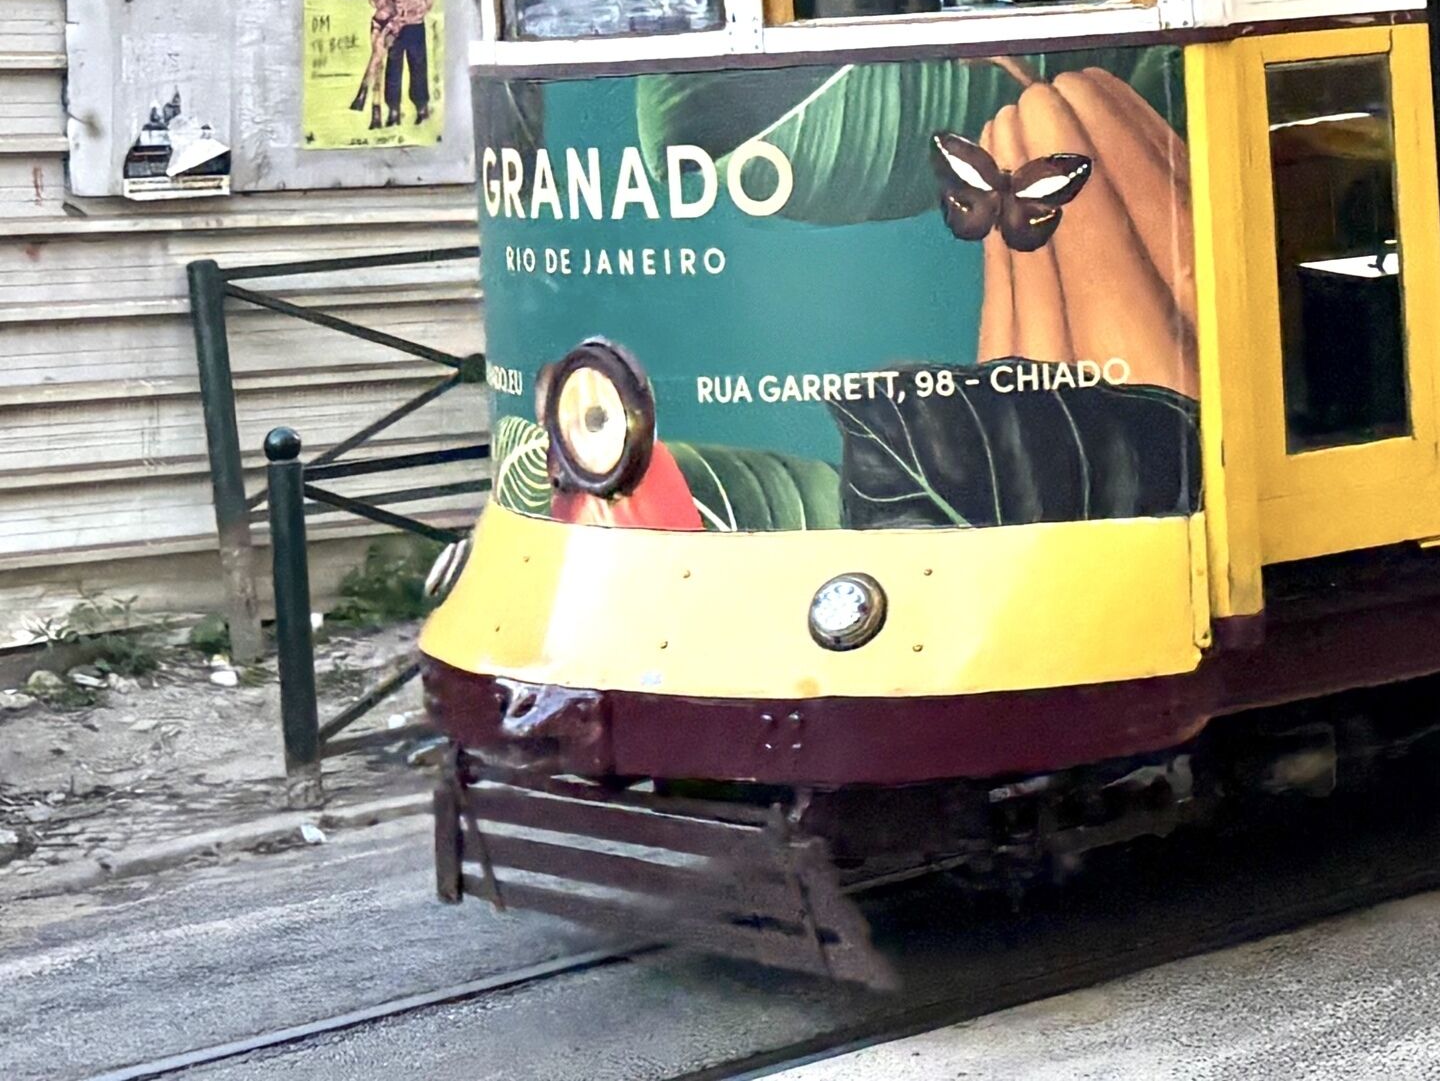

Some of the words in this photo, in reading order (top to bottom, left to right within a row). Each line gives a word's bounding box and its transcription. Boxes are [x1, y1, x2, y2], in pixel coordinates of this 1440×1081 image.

[482, 139, 793, 220] GRANADO
[506, 245, 536, 273] RIO
[545, 248, 571, 275] DE
[583, 247, 726, 276] JANEIRO
[698, 376, 752, 403] RUA
[758, 371, 906, 404] GARRETT,
[916, 370, 955, 398] 98
[990, 358, 1131, 393] CHIADO
